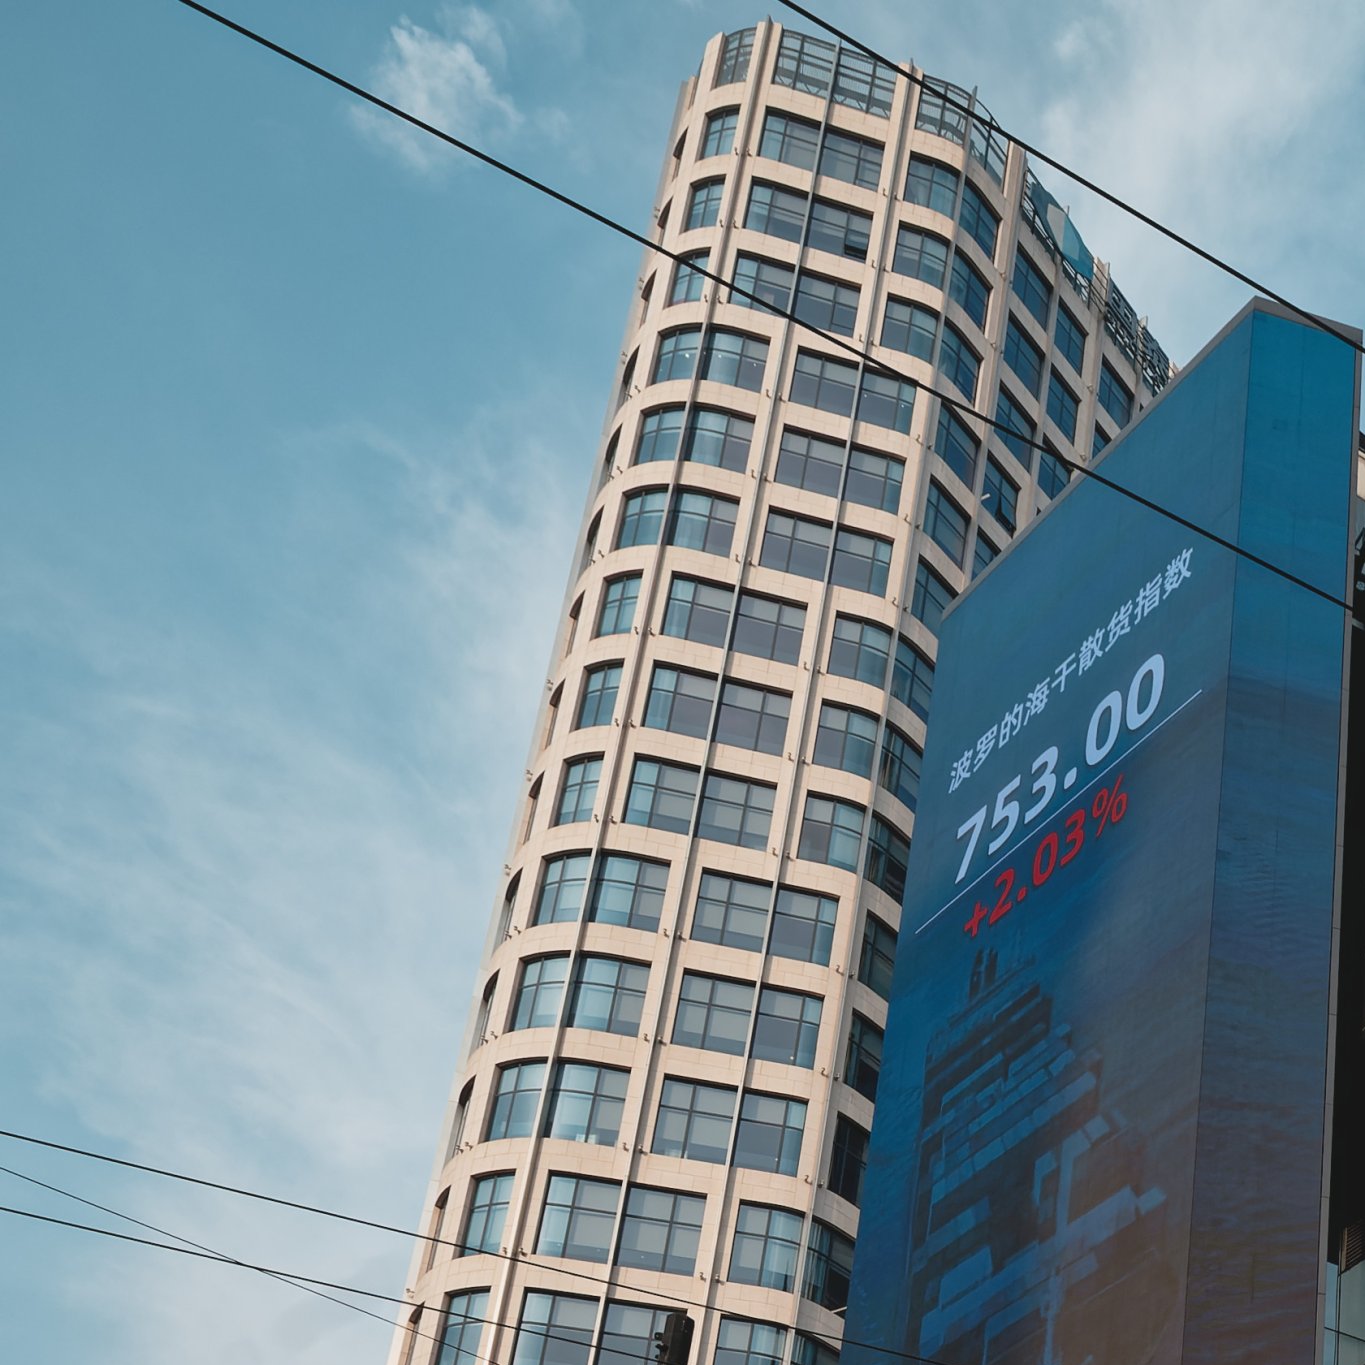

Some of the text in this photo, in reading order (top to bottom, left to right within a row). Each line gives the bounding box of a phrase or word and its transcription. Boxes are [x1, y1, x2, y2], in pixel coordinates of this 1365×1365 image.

[947, 546, 1195, 794] 波罗的海干散货指数
[954, 653, 1166, 885] 753.00
[963, 773, 1129, 938] +2.03%
